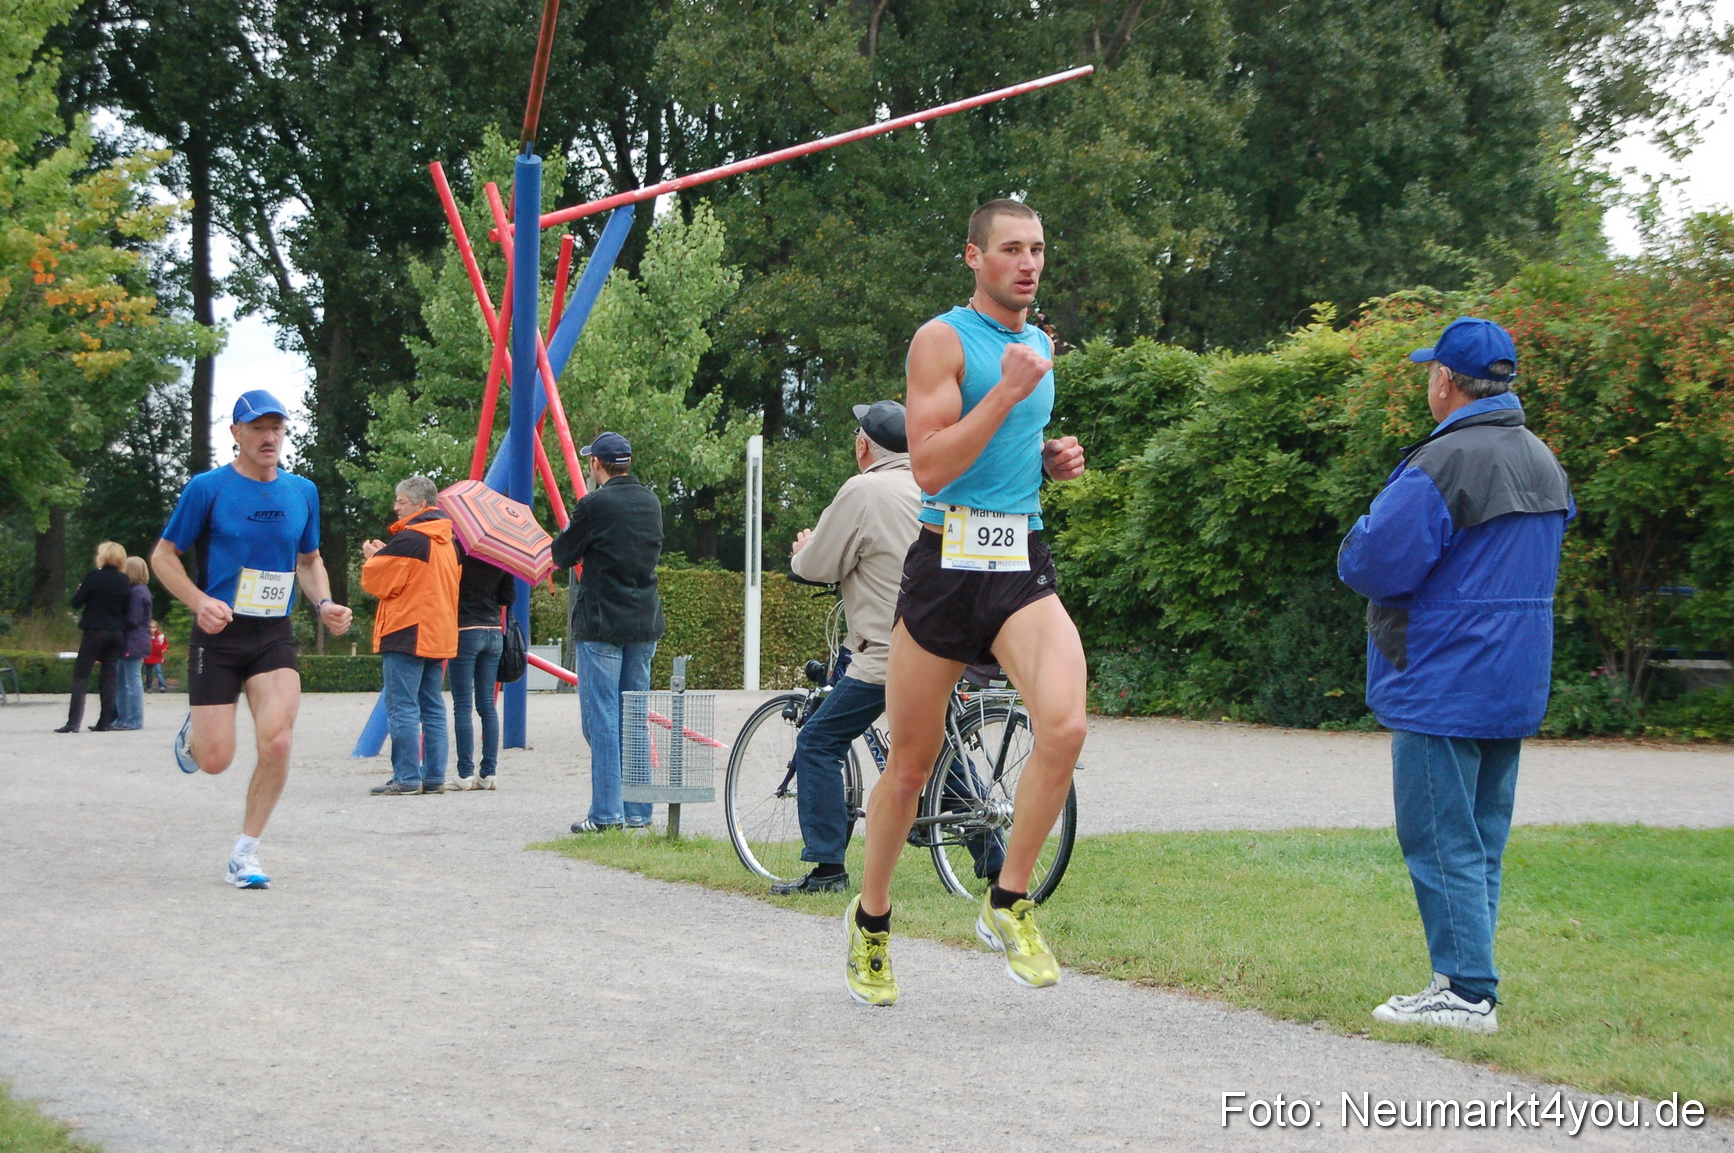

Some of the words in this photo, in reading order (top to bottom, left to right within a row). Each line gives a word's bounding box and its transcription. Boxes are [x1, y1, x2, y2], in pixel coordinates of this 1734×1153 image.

[254, 510, 286, 518] ERTEL
[947, 523, 954, 534] A
[977, 526, 1015, 547] 928
[259, 571, 282, 582] Alfons
[261, 586, 286, 601] 595
